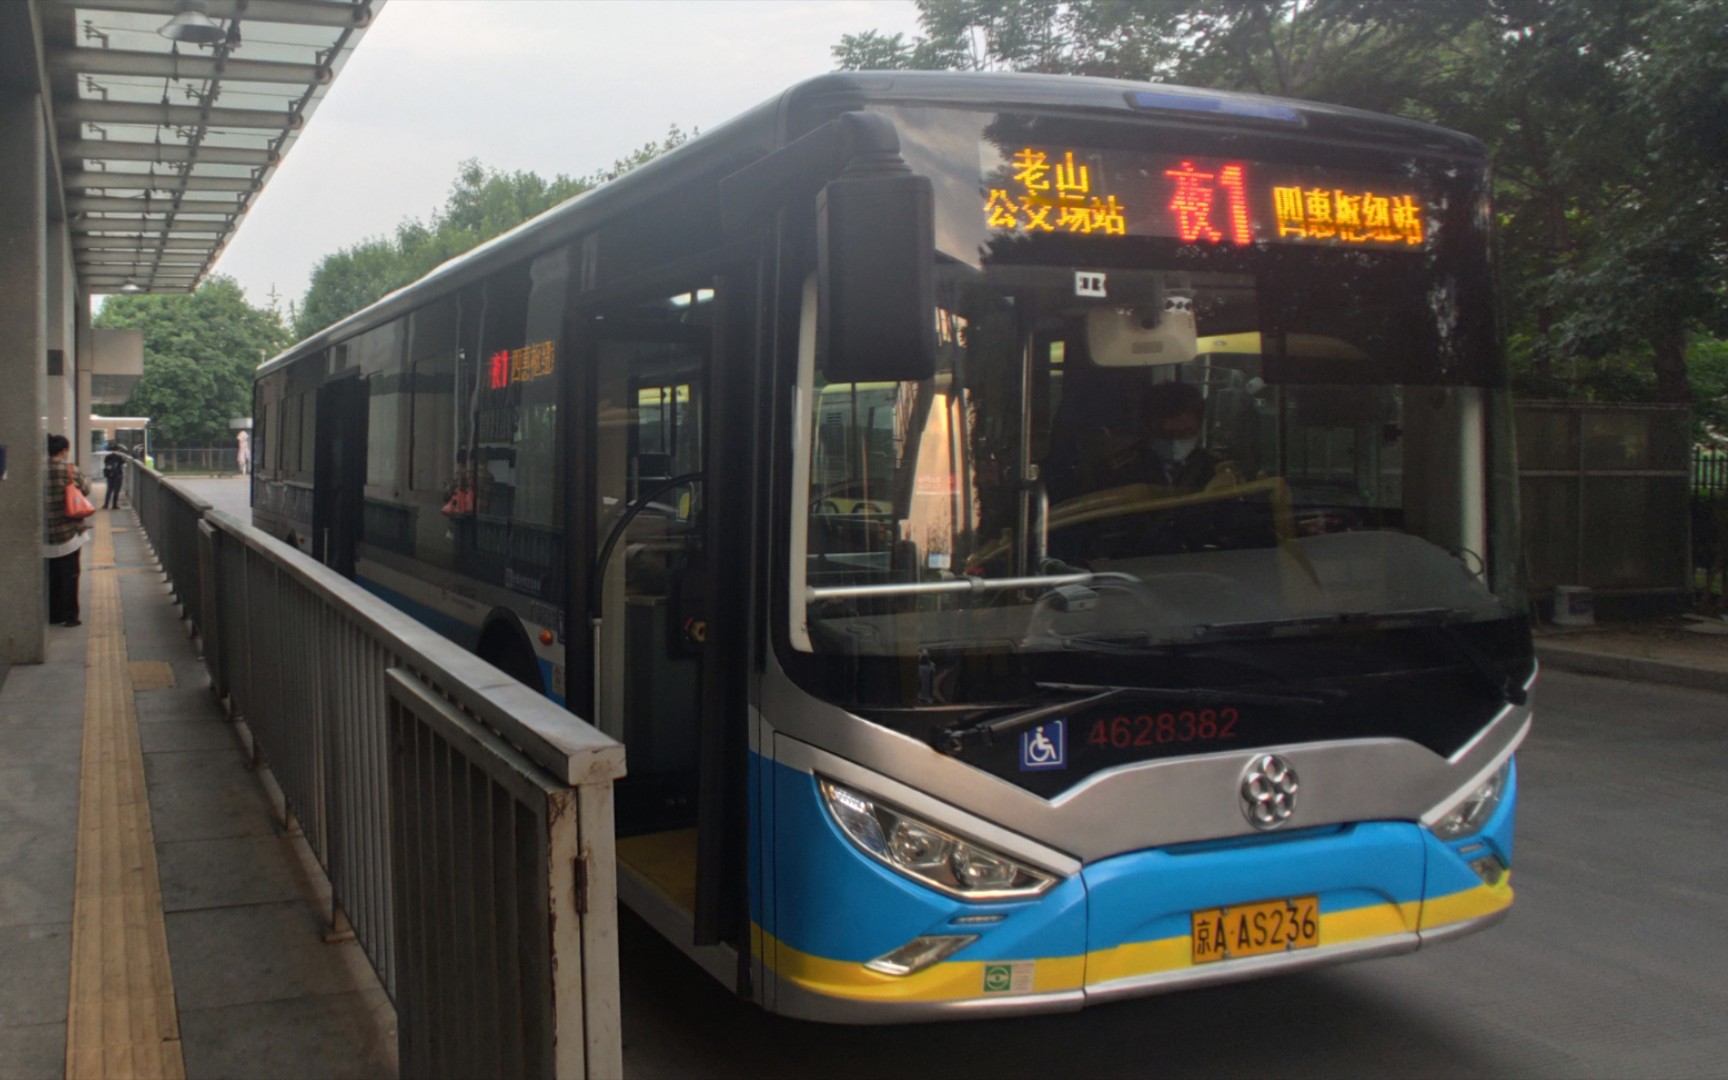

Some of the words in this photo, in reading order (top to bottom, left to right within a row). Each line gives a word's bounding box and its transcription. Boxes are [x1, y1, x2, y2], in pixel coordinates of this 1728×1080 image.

[1011, 147, 1089, 193] 老山
[983, 188, 1126, 235] 公交场站
[1088, 706, 1239, 748] 4628382
